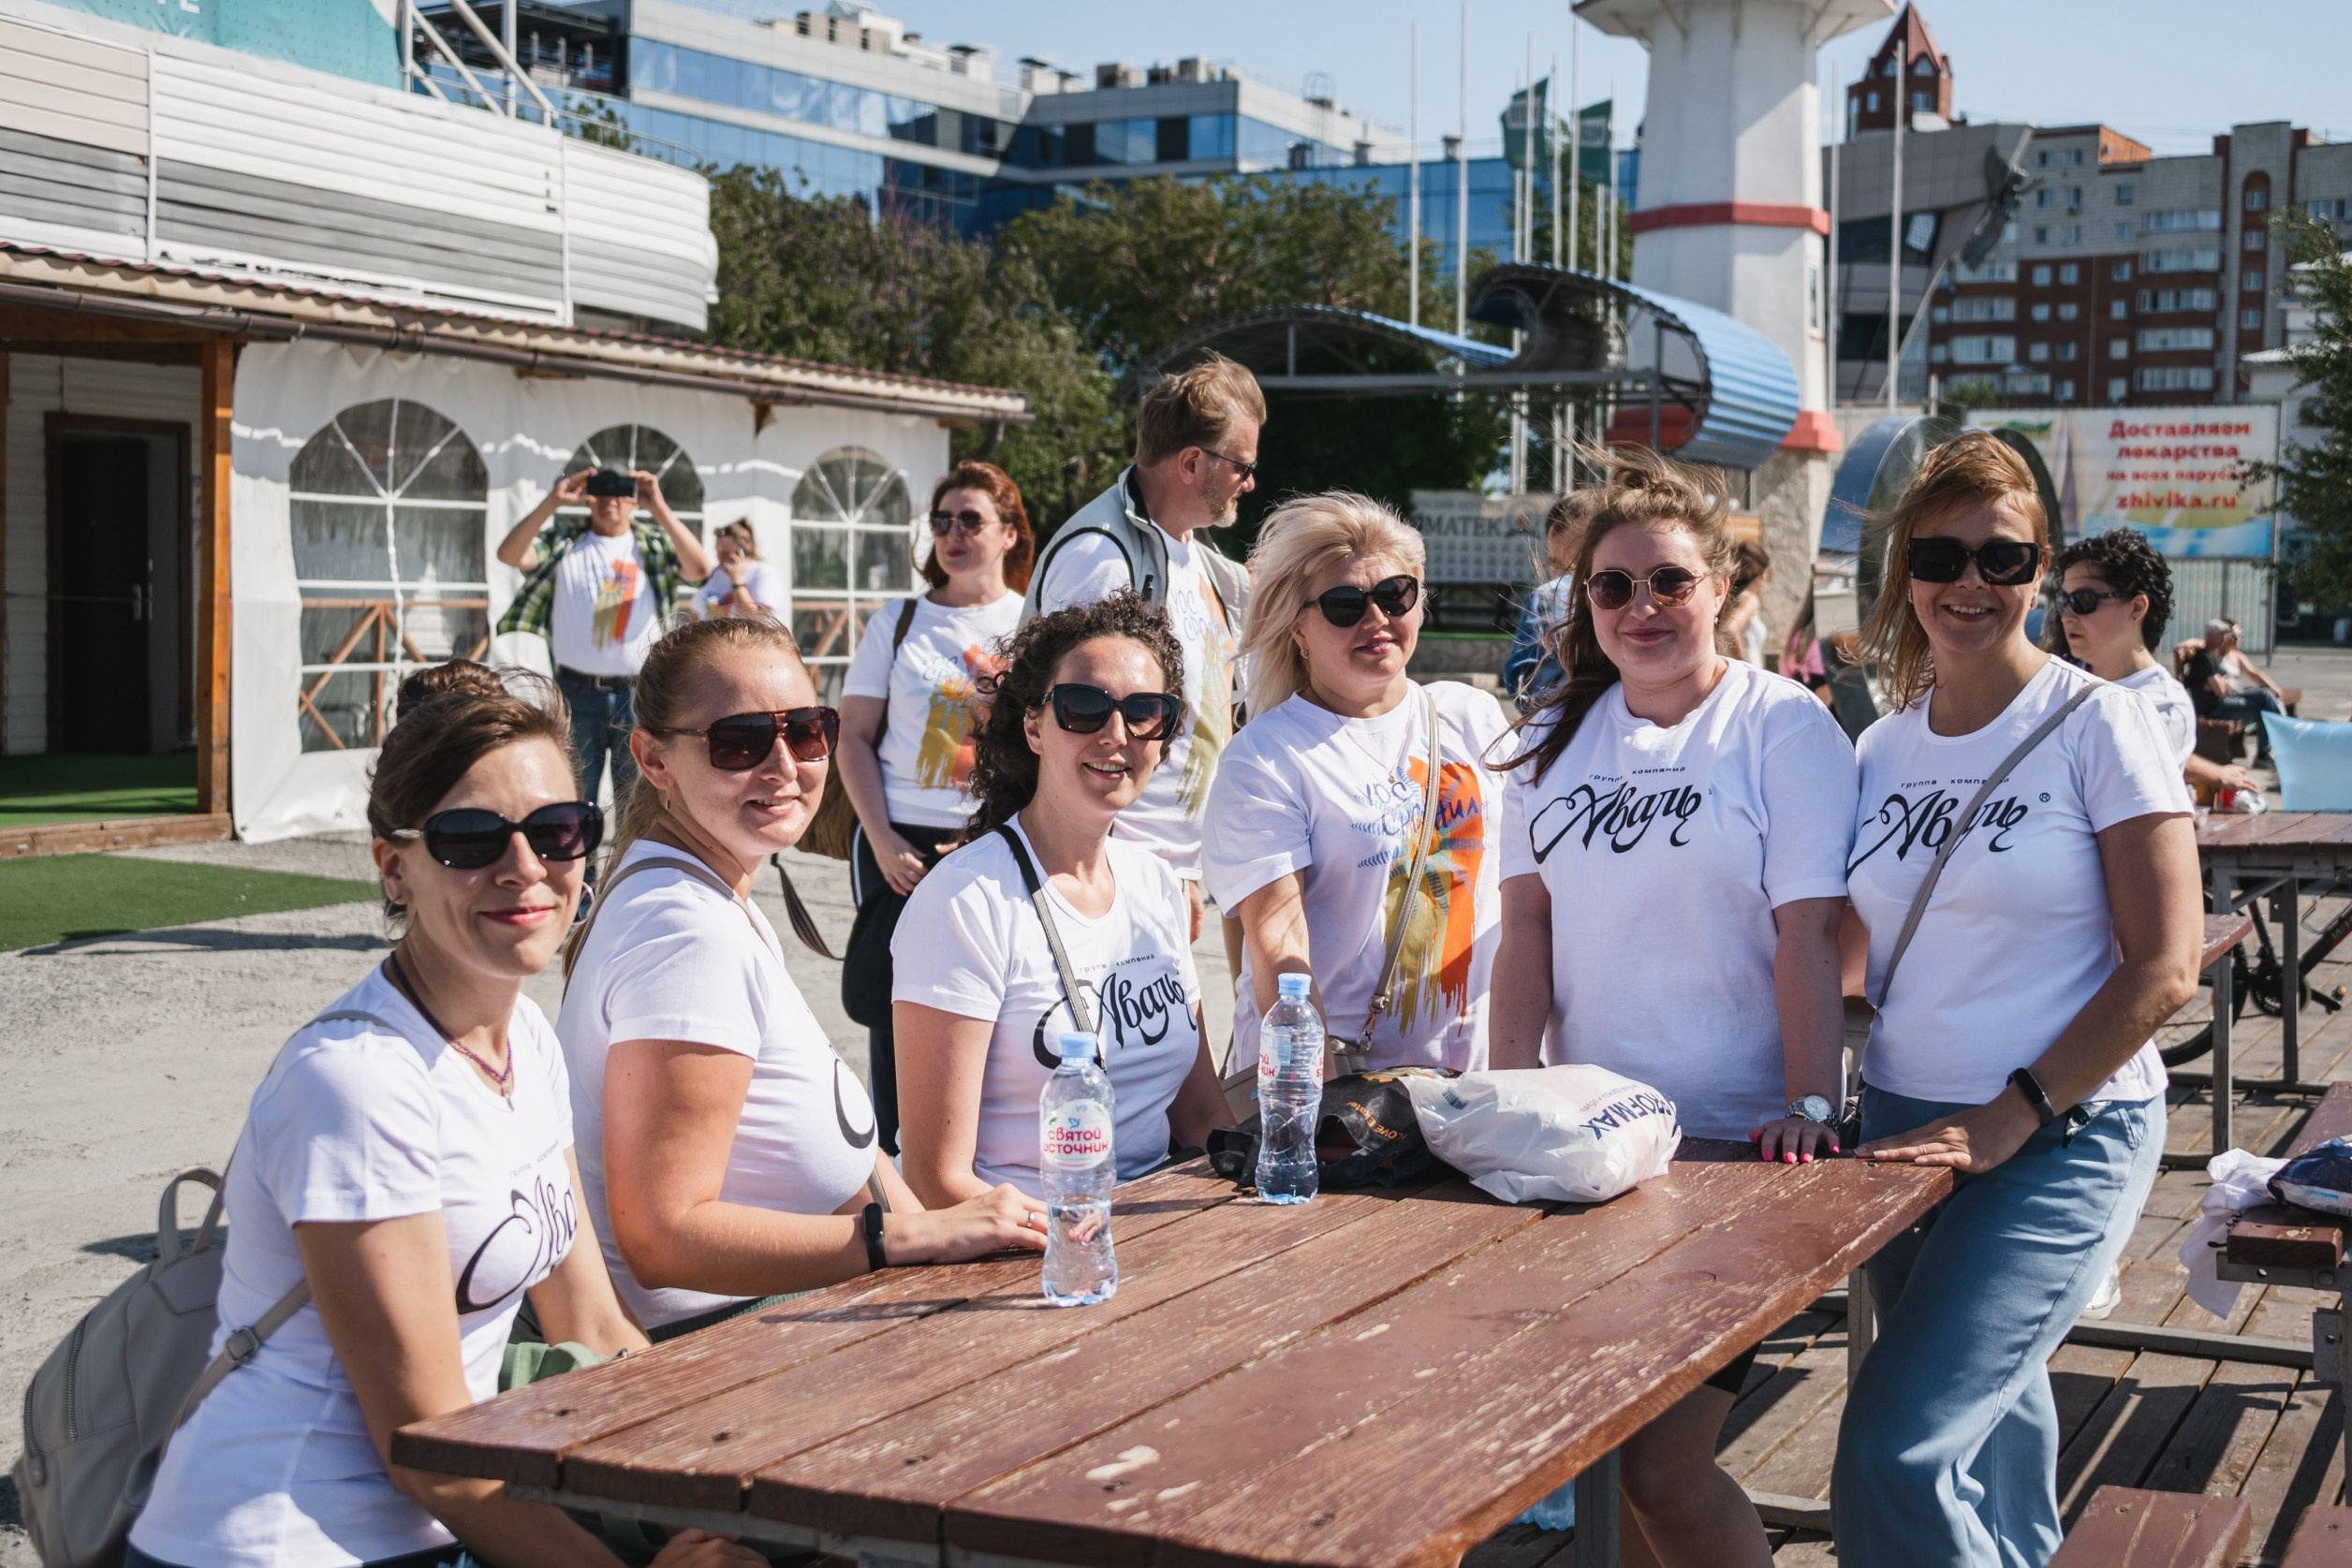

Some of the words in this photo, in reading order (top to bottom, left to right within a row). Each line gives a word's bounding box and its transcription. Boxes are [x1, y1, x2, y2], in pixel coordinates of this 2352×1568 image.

[2109, 419, 2250, 440] Доставляем
[2117, 445, 2239, 462] лекарства
[2107, 470, 2126, 481] на
[2132, 470, 2169, 481] всех
[2116, 491, 2236, 509] zhivika.ru
[1632, 766, 1686, 775] компаний
[1901, 779, 1937, 788] группа
[1116, 953, 1155, 967] компаний
